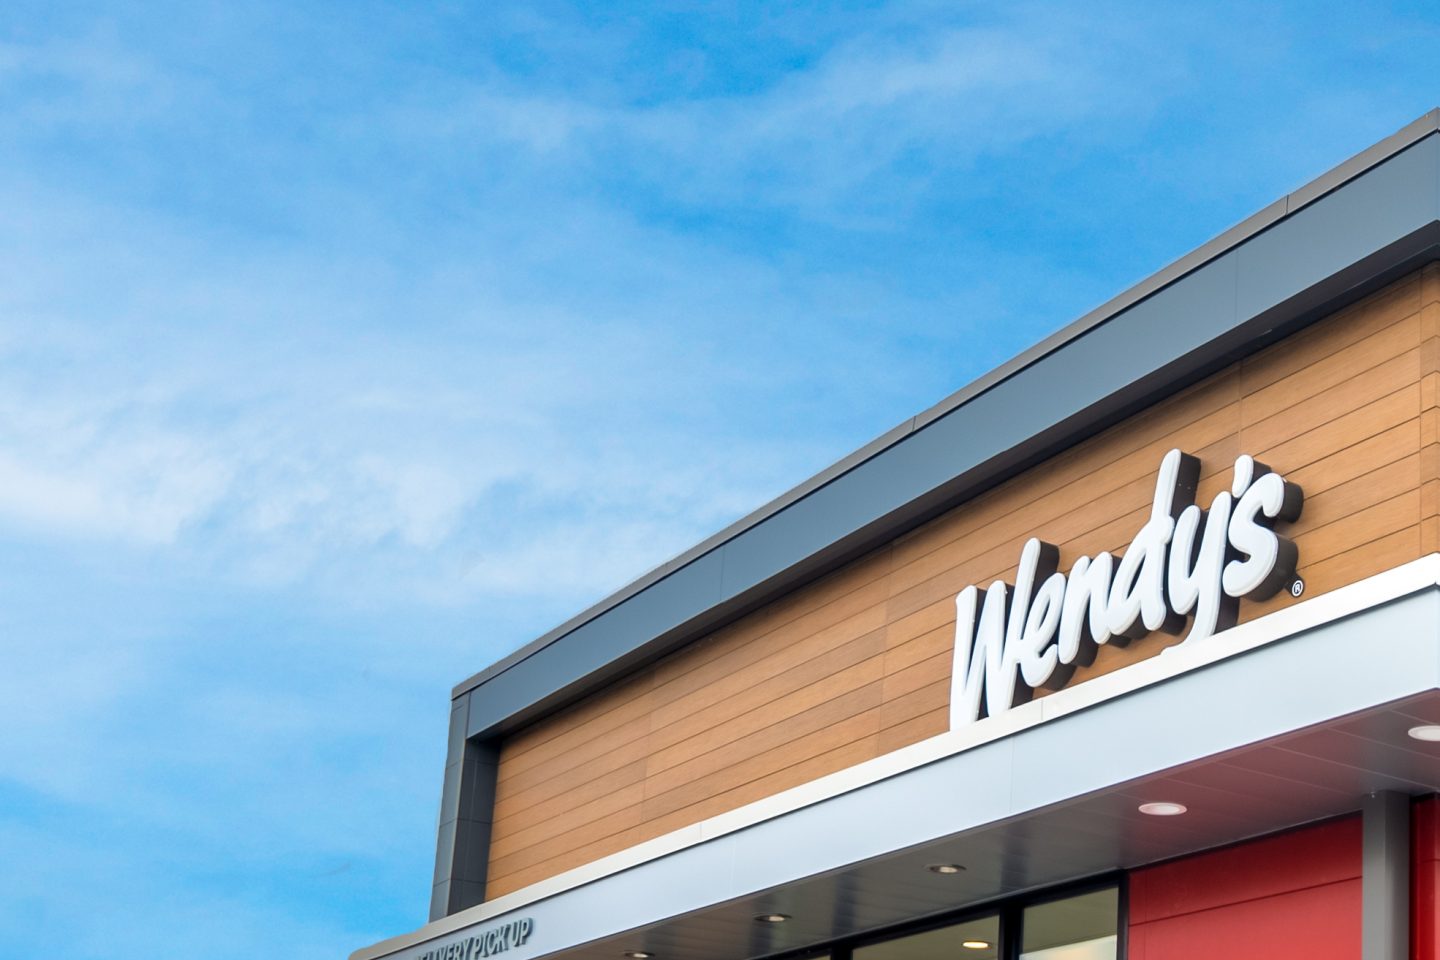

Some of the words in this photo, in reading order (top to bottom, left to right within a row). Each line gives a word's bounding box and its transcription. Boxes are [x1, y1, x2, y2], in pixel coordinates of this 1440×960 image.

[949, 447, 1290, 731] Wendy's
[474, 924, 511, 960] PICK
[511, 917, 534, 948] UP
